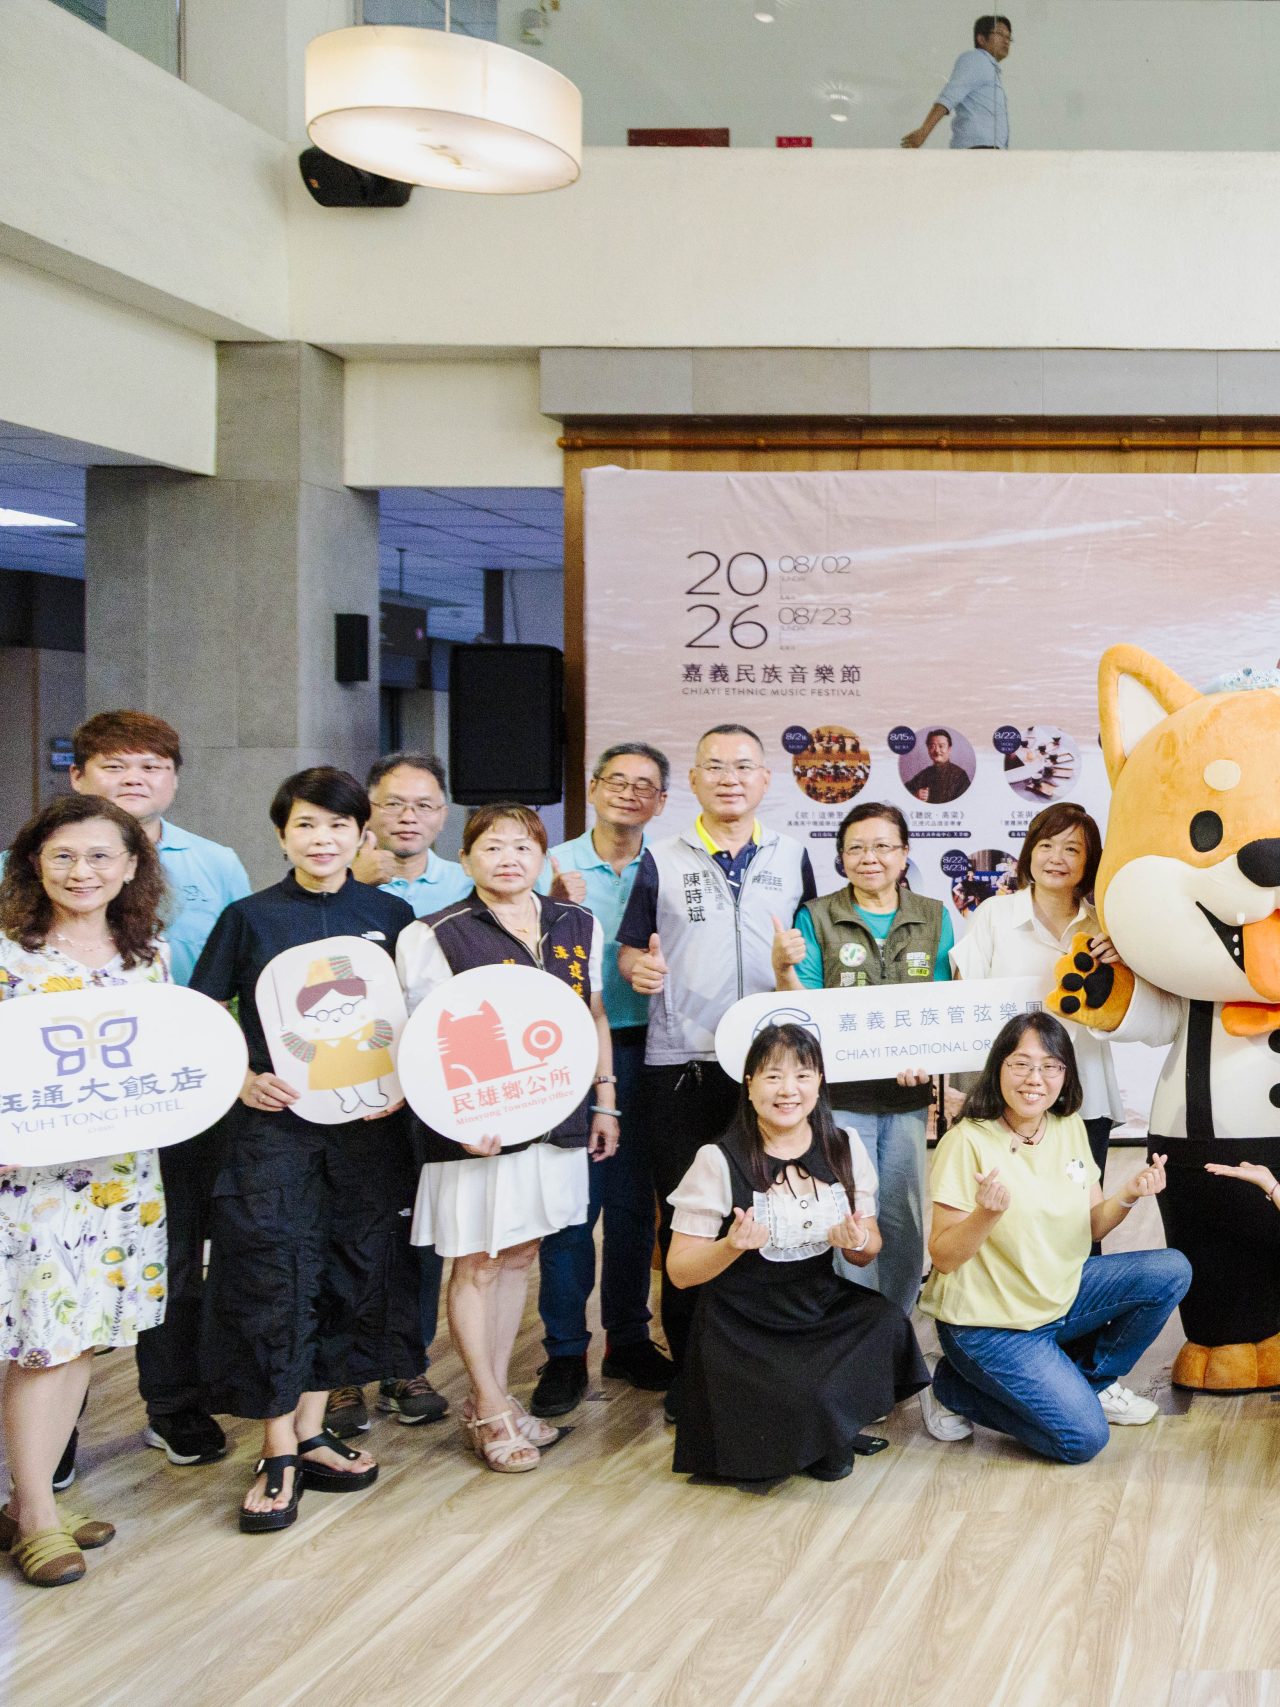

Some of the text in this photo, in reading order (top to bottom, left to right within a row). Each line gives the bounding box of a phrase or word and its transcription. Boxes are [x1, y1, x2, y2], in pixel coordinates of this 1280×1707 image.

[685, 551, 768, 596] 20
[778, 555, 851, 574] 08/02
[684, 604, 768, 649] 26
[778, 607, 852, 625] 08/23
[682, 663, 861, 684] 嘉義民族音樂節
[682, 687, 861, 697] CHIAYI ETHNIC MUSIC FESTIVAL
[683, 872, 706, 922] 陳時斌
[835, 1039, 992, 1062] CHIAYI TRADITIONAL OR
[452, 1066, 571, 1114] 民雄鄉公所
[11, 1099, 184, 1134] YUH TONG HOTEL
